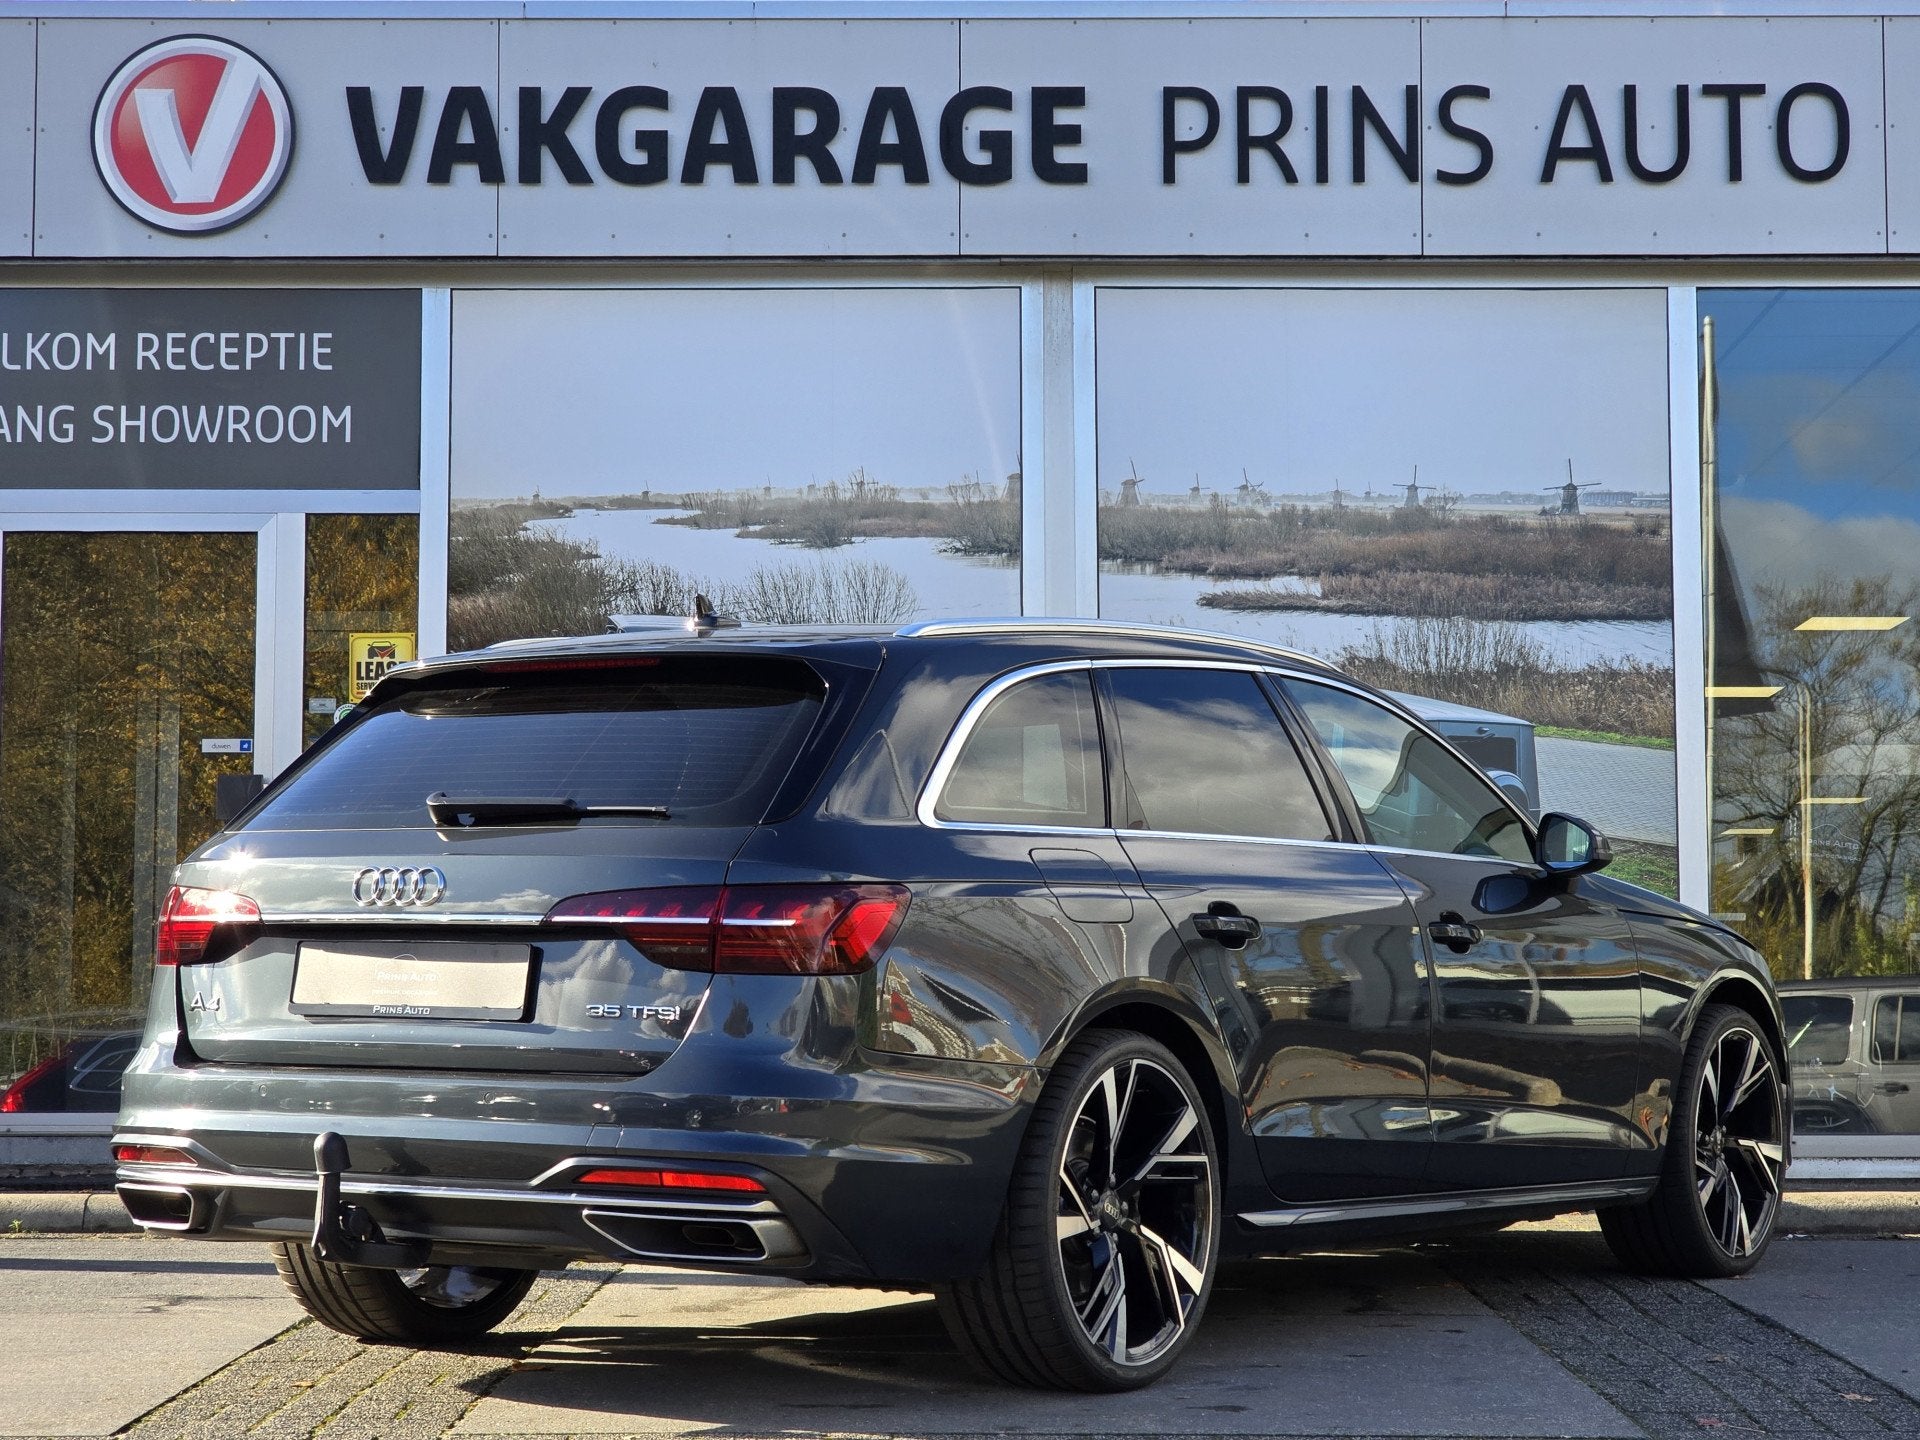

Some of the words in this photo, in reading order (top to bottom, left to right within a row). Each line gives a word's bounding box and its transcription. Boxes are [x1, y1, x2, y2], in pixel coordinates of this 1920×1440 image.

[346, 86, 1089, 186] VAKGARAGE
[1163, 85, 1495, 185] PRINS
[1541, 82, 1851, 184] AUTO
[2, 332, 116, 371] LKOM
[136, 332, 333, 371] RECEPTIE
[91, 404, 352, 444] SHOWROOM
[356, 661, 405, 681] LEA
[189, 990, 220, 1011] A4
[404, 1006, 431, 1015] AUTO
[586, 1004, 621, 1018] 35
[626, 1005, 681, 1021] TFSI
